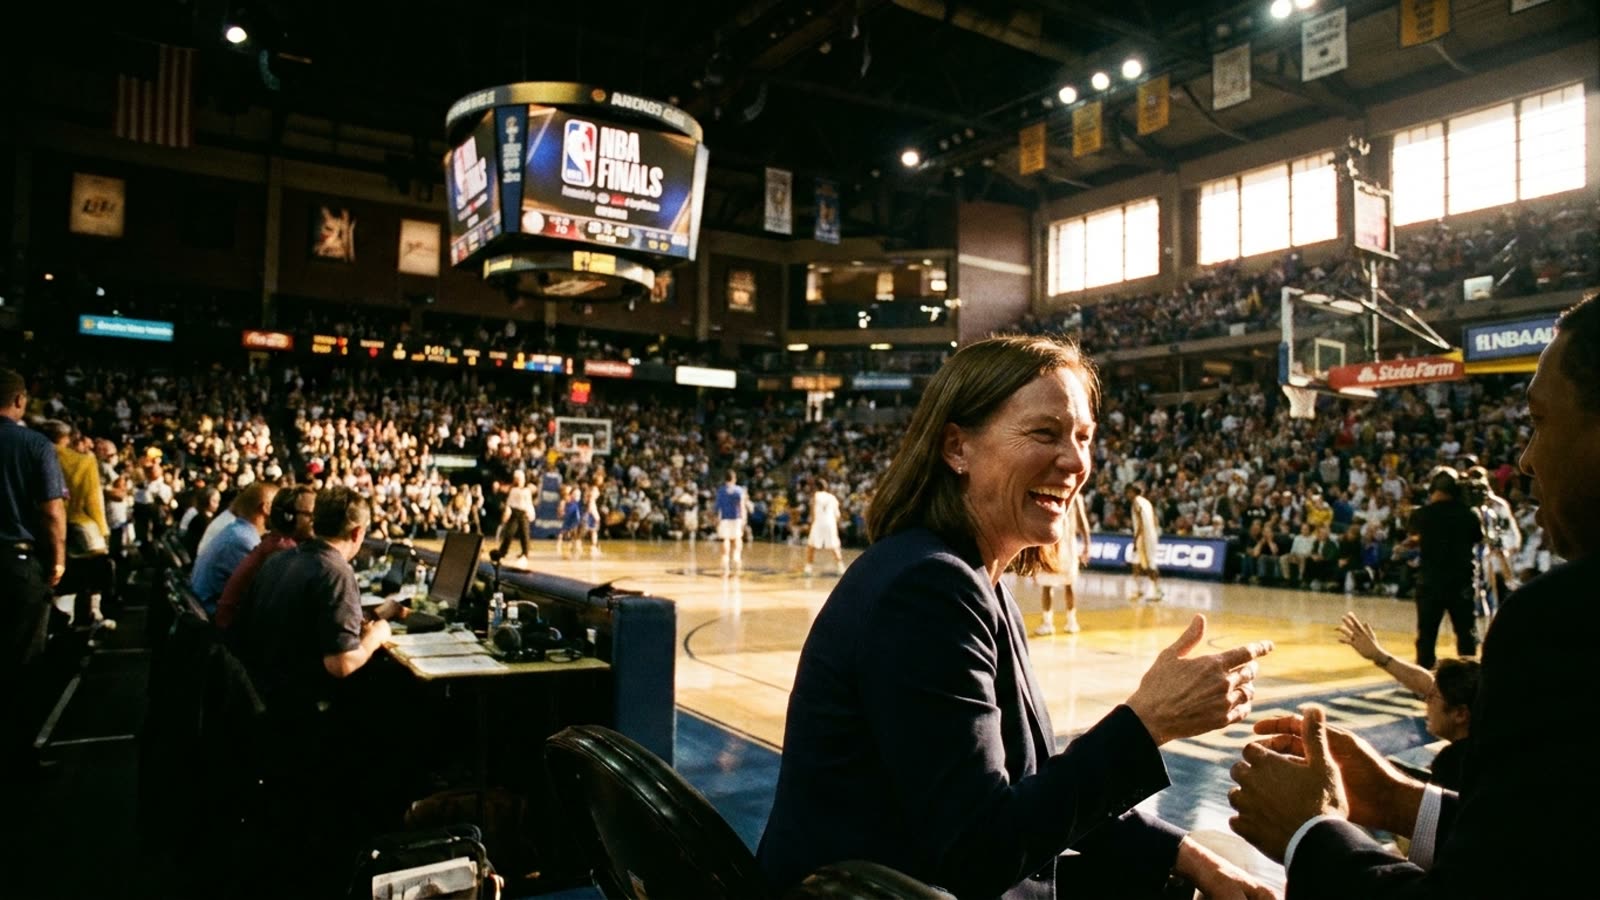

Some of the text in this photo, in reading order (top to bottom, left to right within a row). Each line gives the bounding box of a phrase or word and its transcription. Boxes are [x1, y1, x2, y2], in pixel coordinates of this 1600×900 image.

[600, 126, 640, 163] NBA
[597, 158, 664, 198] FINALS
[1379, 362, 1455, 381] State Farm
